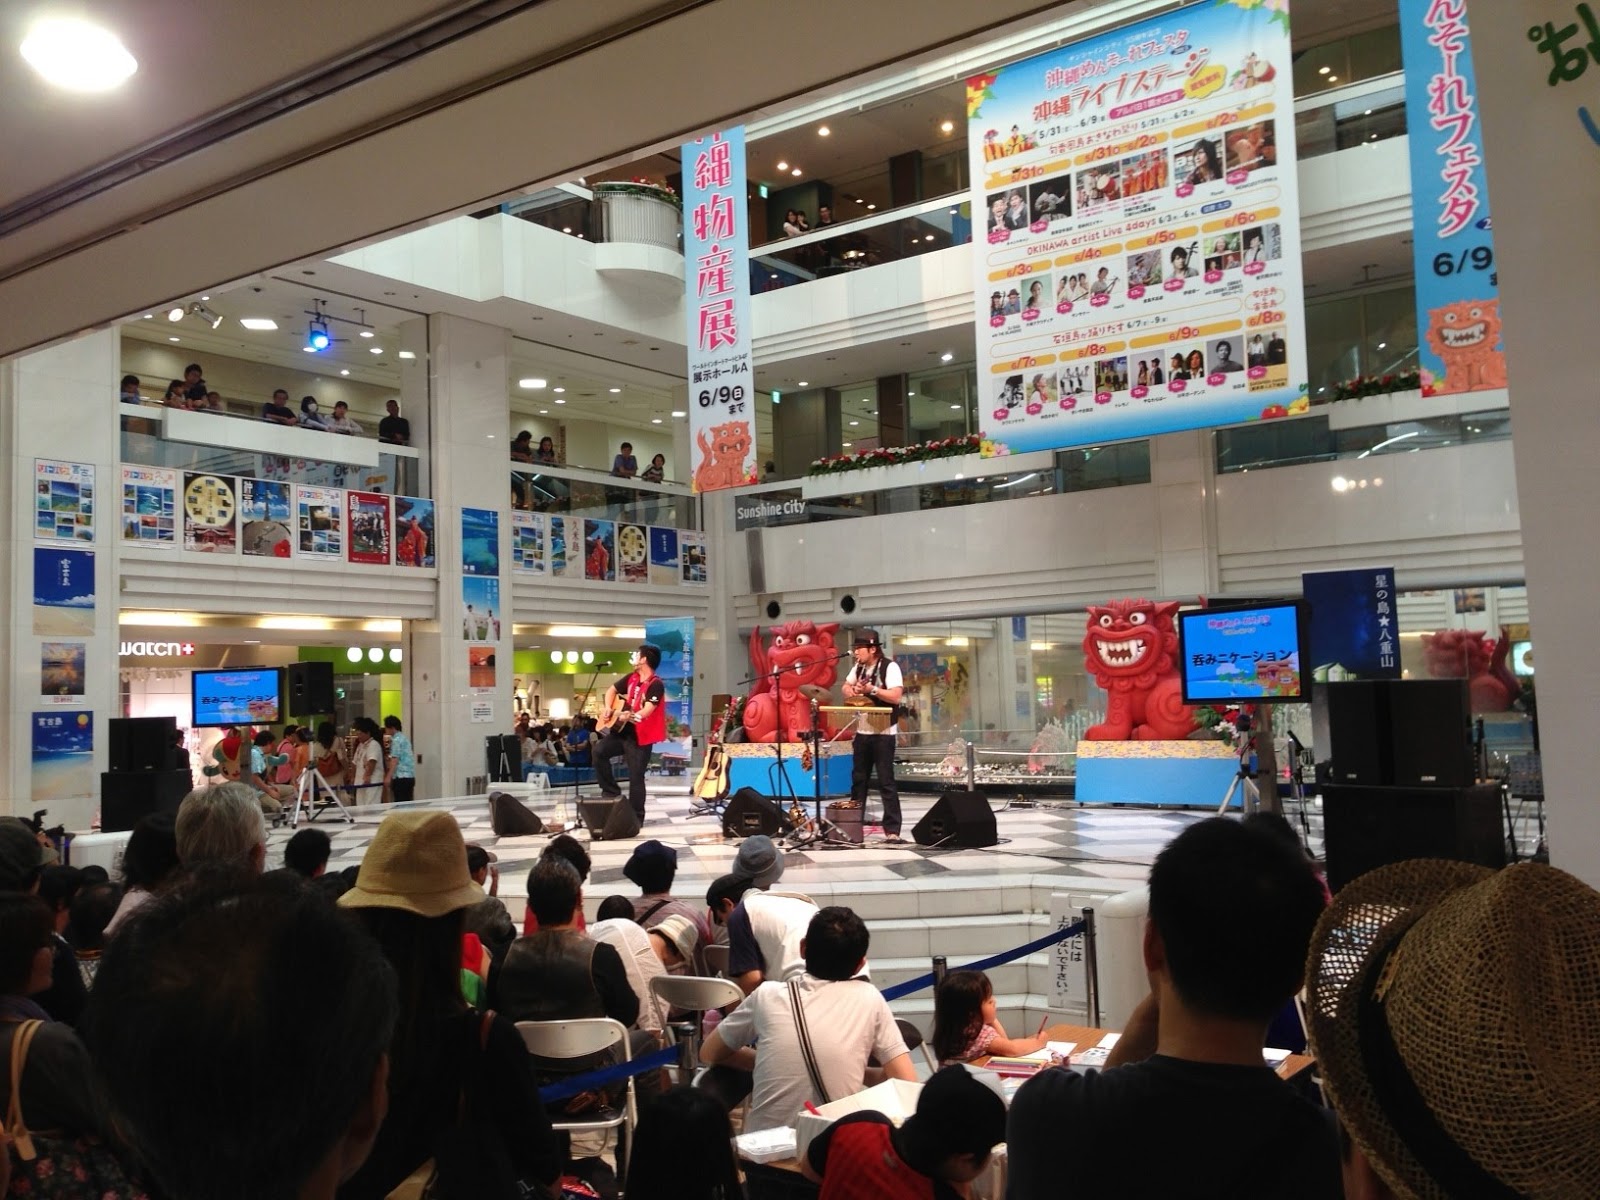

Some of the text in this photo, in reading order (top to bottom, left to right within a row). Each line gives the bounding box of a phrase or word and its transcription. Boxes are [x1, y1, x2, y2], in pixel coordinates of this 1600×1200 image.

[1046, 29, 1190, 88] 沖縄めんそーれフェスタ
[1033, 48, 1209, 121] 沖縄ライブステージ
[693, 131, 736, 351] 縄物産展
[1027, 239, 1069, 256] OKINAWA
[1071, 232, 1100, 245] artist
[1103, 225, 1123, 239] Live
[1125, 218, 1157, 235] 4days
[693, 362, 748, 383] 展示ホールA
[728, 402, 745, 415] まで
[737, 499, 806, 519] Sunshine City
[1192, 649, 1293, 668] 呑みニケーション
[201, 694, 275, 706] 呑みニケーション
